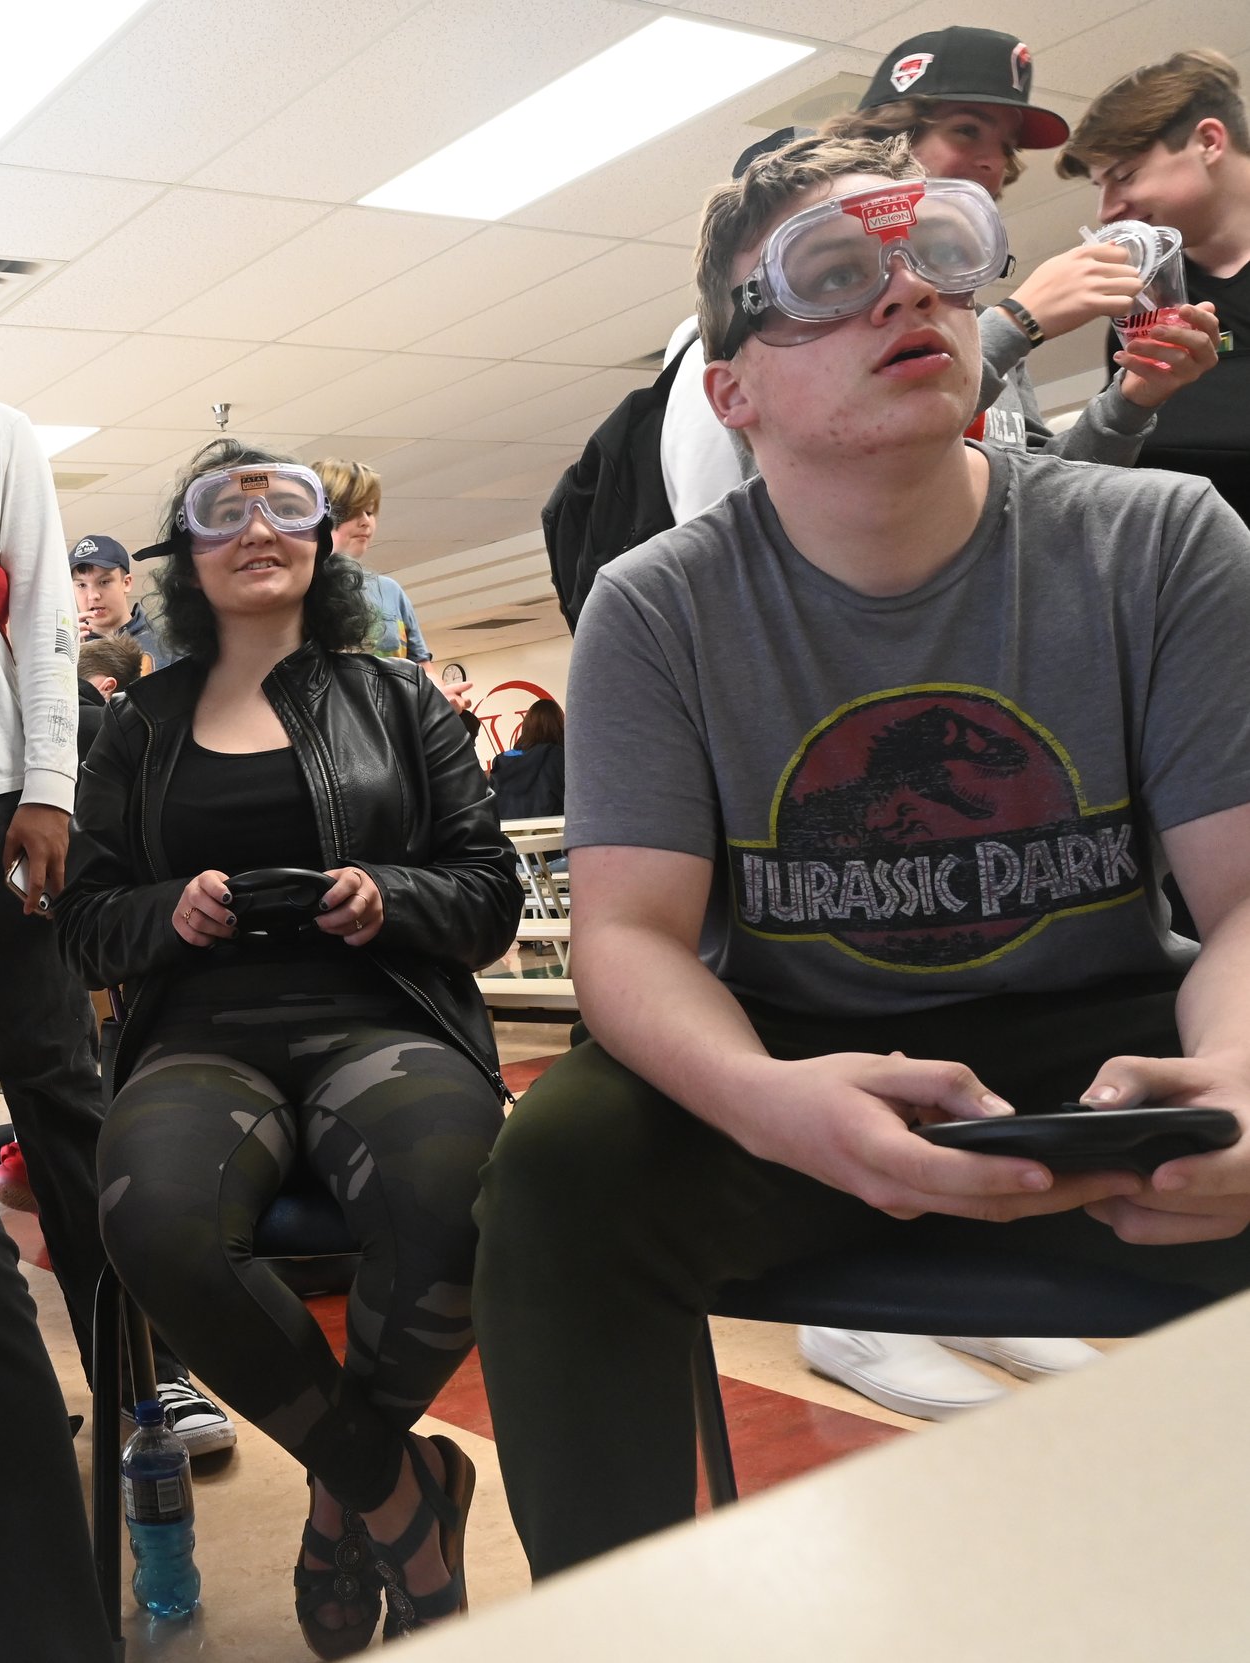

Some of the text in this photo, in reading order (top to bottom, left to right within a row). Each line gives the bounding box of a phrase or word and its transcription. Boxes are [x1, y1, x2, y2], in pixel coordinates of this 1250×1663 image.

[866, 204, 908, 217] FATAL
[869, 212, 910, 226] VISION
[742, 822, 1139, 925] JURASSIC PARK
